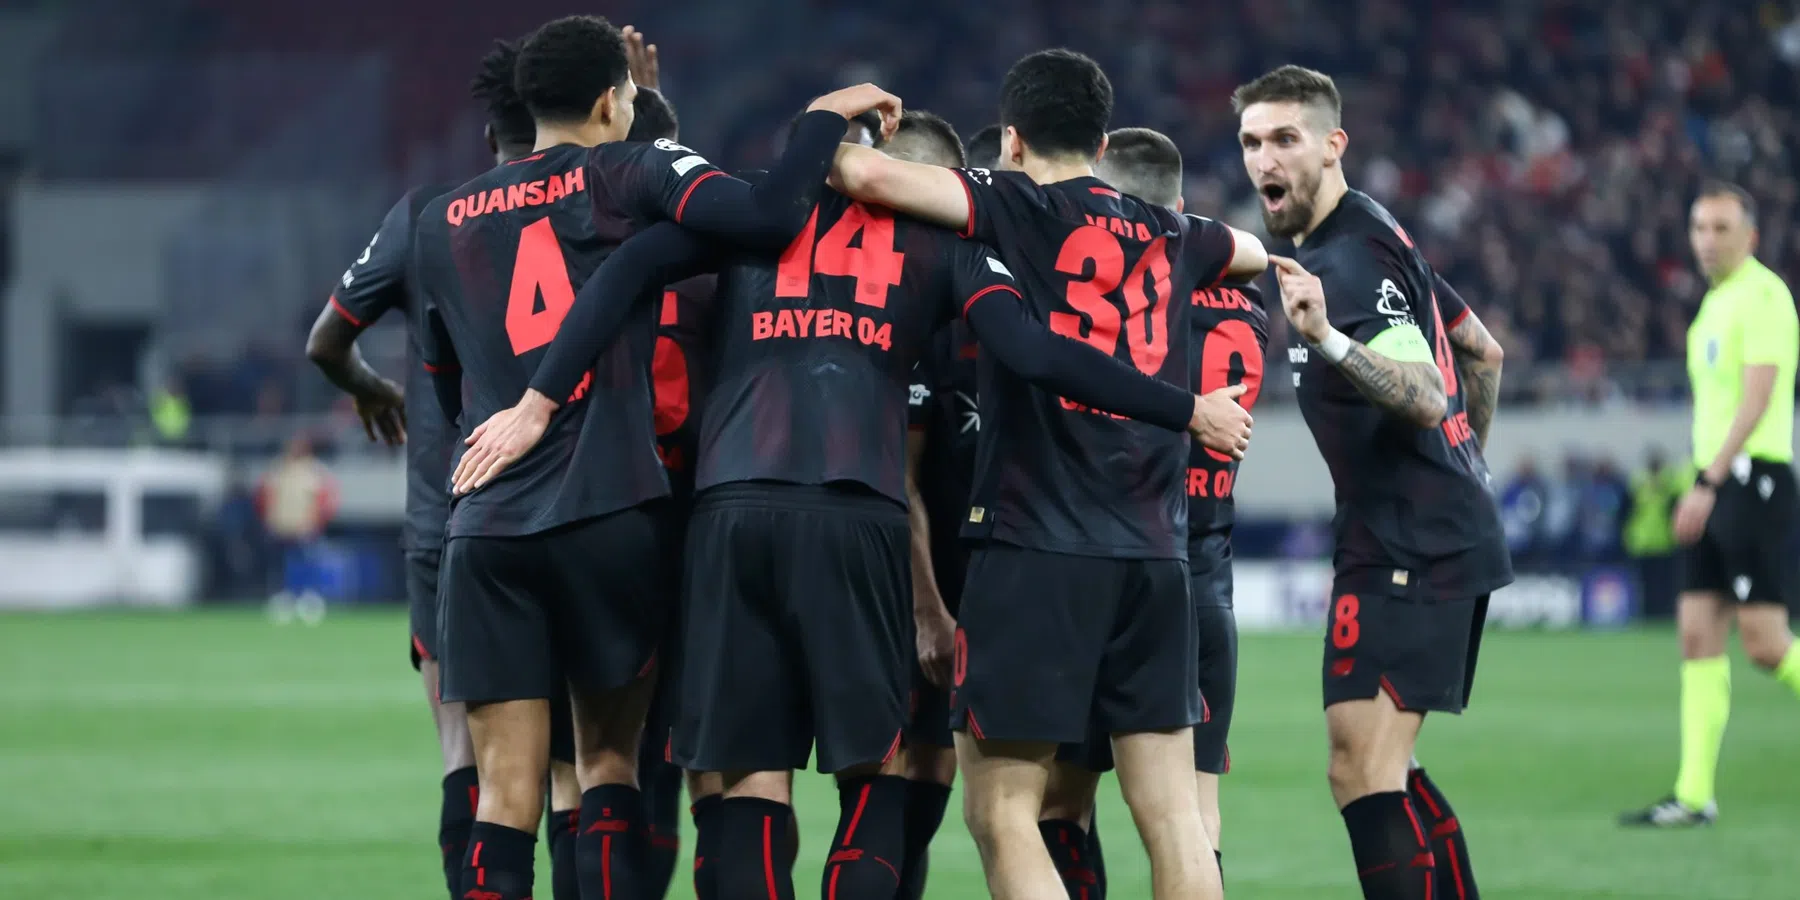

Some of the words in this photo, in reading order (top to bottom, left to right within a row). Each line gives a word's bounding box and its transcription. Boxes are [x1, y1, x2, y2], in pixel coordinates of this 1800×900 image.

[446, 166, 585, 226] QUANSAH
[505, 215, 577, 357] 4
[775, 202, 905, 309] 14
[752, 308, 853, 341] BAYER
[857, 316, 893, 351] 04
[1050, 225, 1173, 376] 30
[1333, 593, 1361, 650] 8
